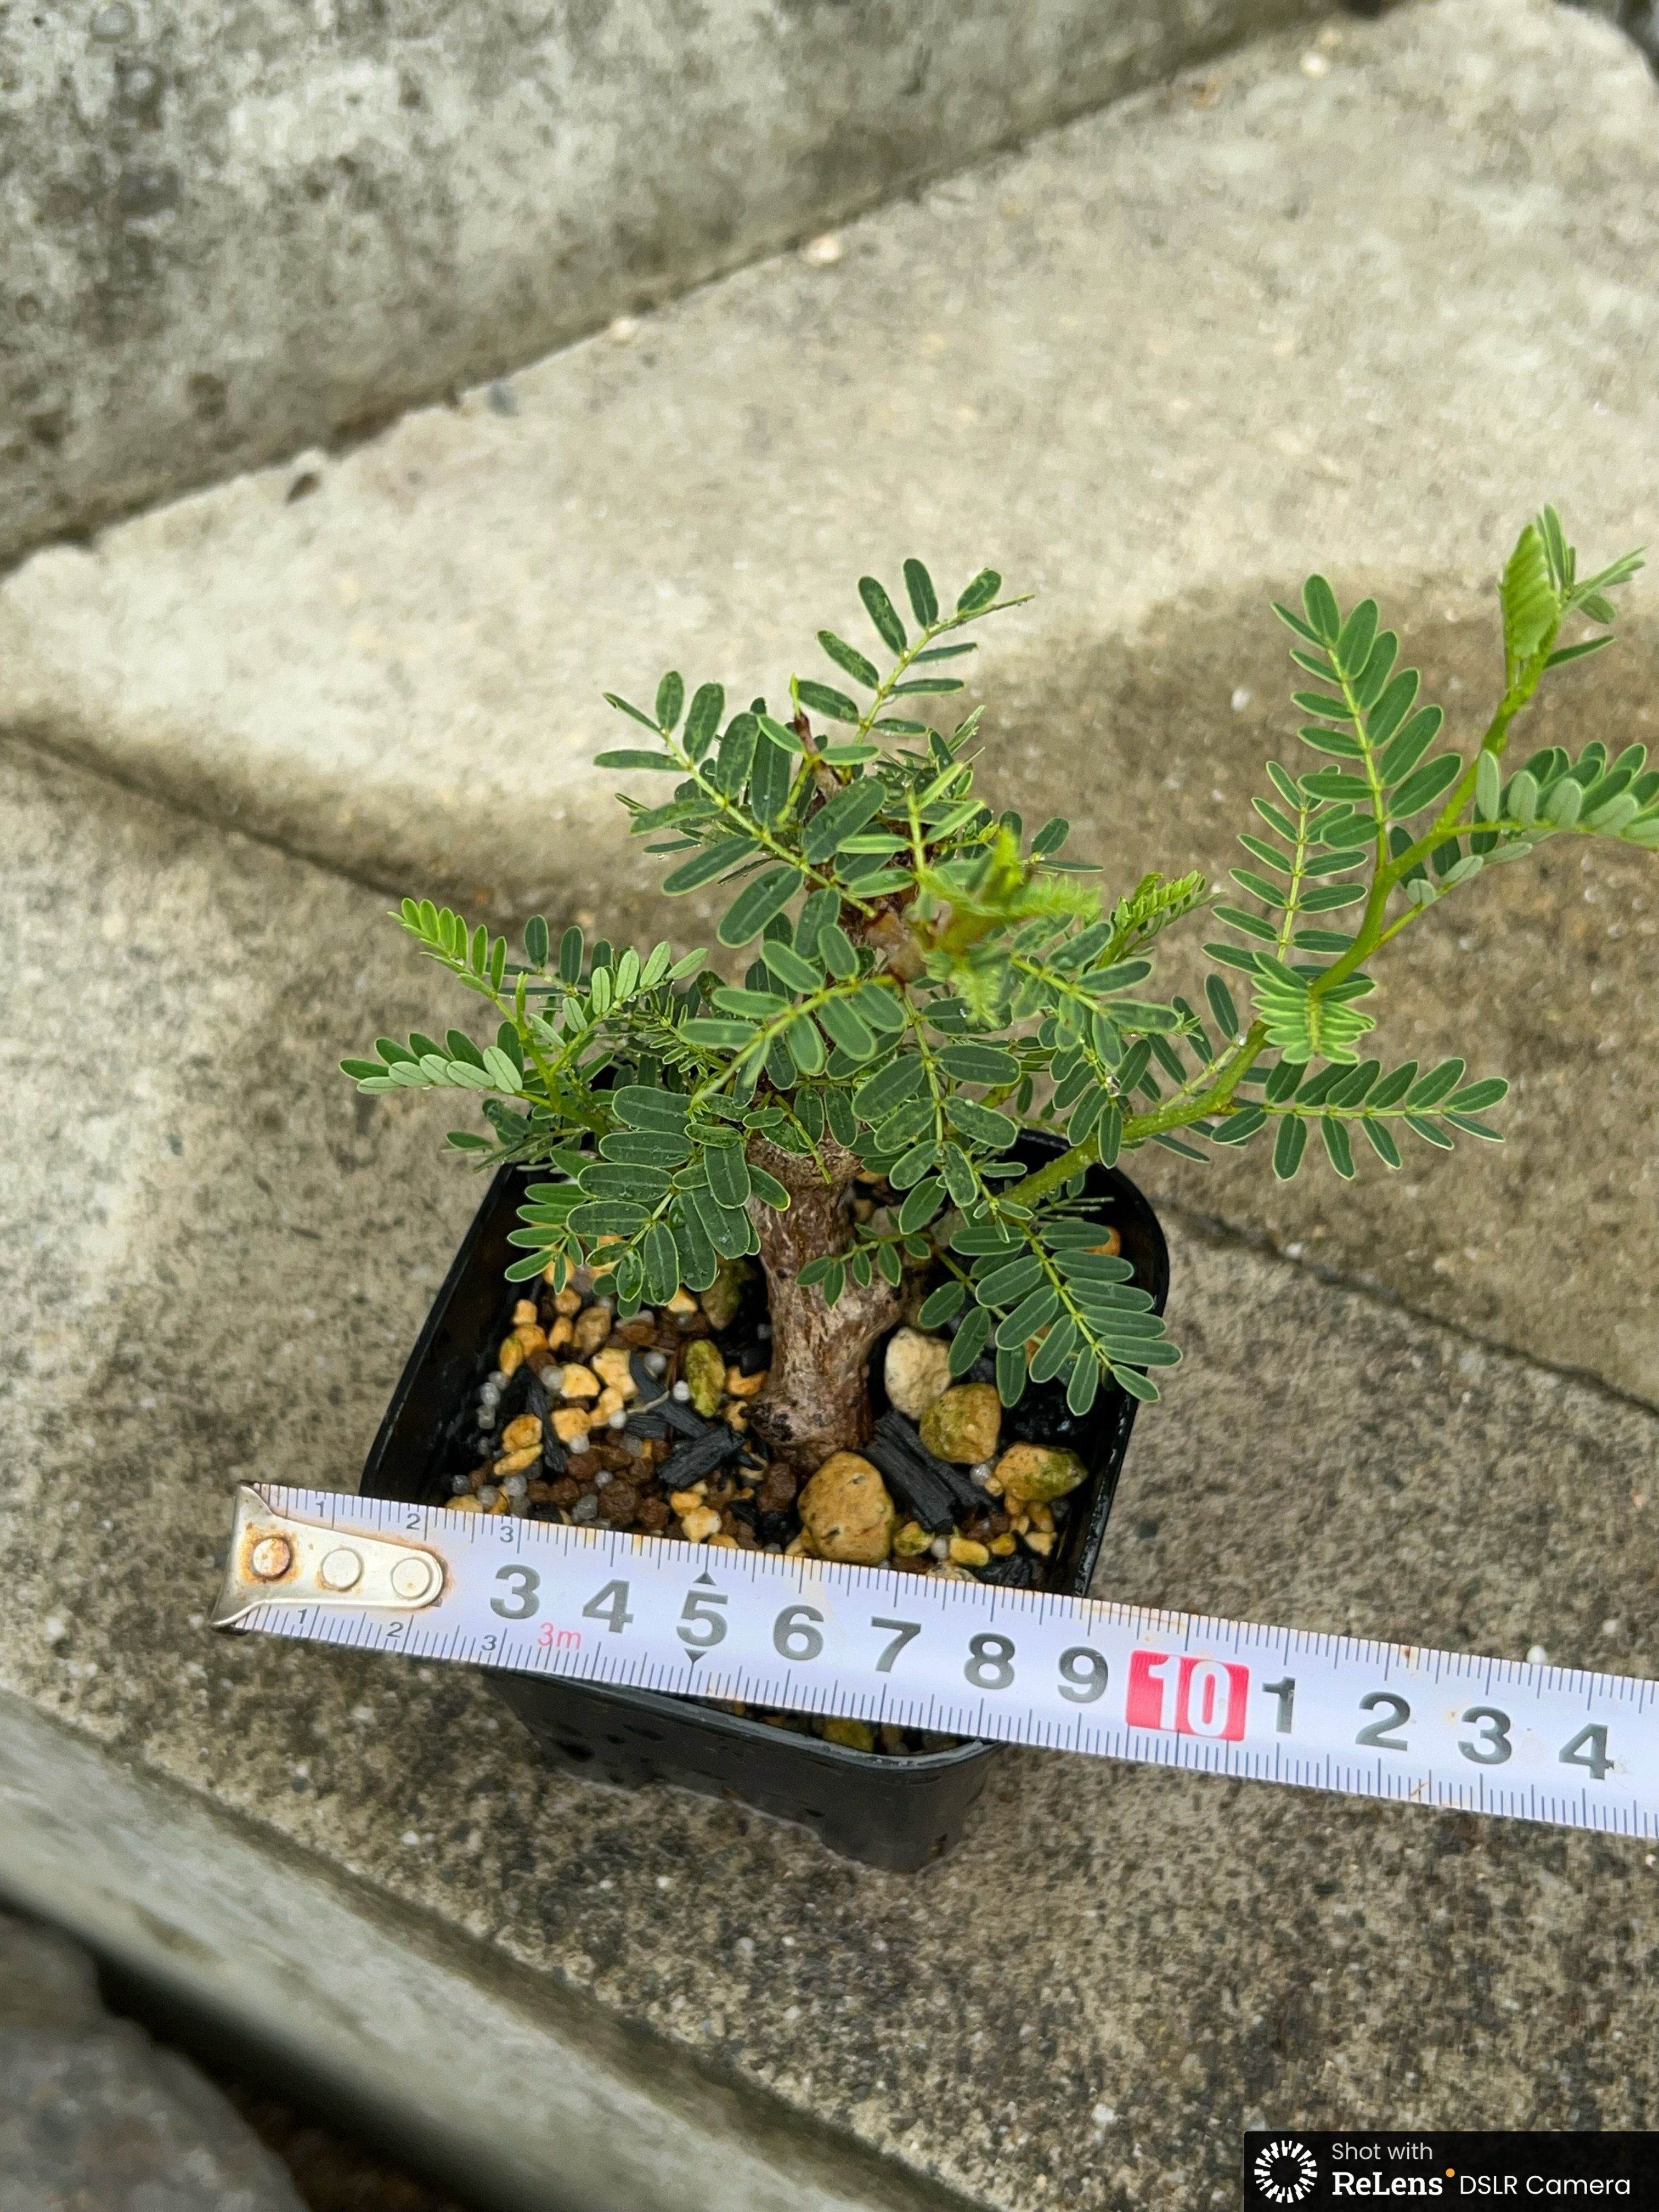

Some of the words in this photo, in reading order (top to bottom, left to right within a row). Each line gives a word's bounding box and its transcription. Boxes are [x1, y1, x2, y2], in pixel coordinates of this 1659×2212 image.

[315, 1500, 325, 1517] 1
[406, 1513, 421, 1531] 2
[500, 1525, 514, 1543] 3
[298, 1609, 309, 1625] 1
[387, 1622, 403, 1638] 2
[481, 1634, 497, 1651] 3
[537, 1622, 582, 1650] 3m
[490, 1564, 541, 1620] 3
[582, 1579, 634, 1634] 4
[676, 1590, 729, 1646] 5
[773, 1605, 824, 1661] 6
[871, 1616, 921, 1673] 7
[964, 1633, 1015, 1689] 8
[1057, 1646, 1109, 1703] 9
[1147, 1655, 1231, 1737] 10
[1262, 1676, 1295, 1734] 1
[1355, 1691, 1410, 1752] 2
[1458, 1706, 1512, 1765] 3
[1559, 1723, 1615, 1780] 4
